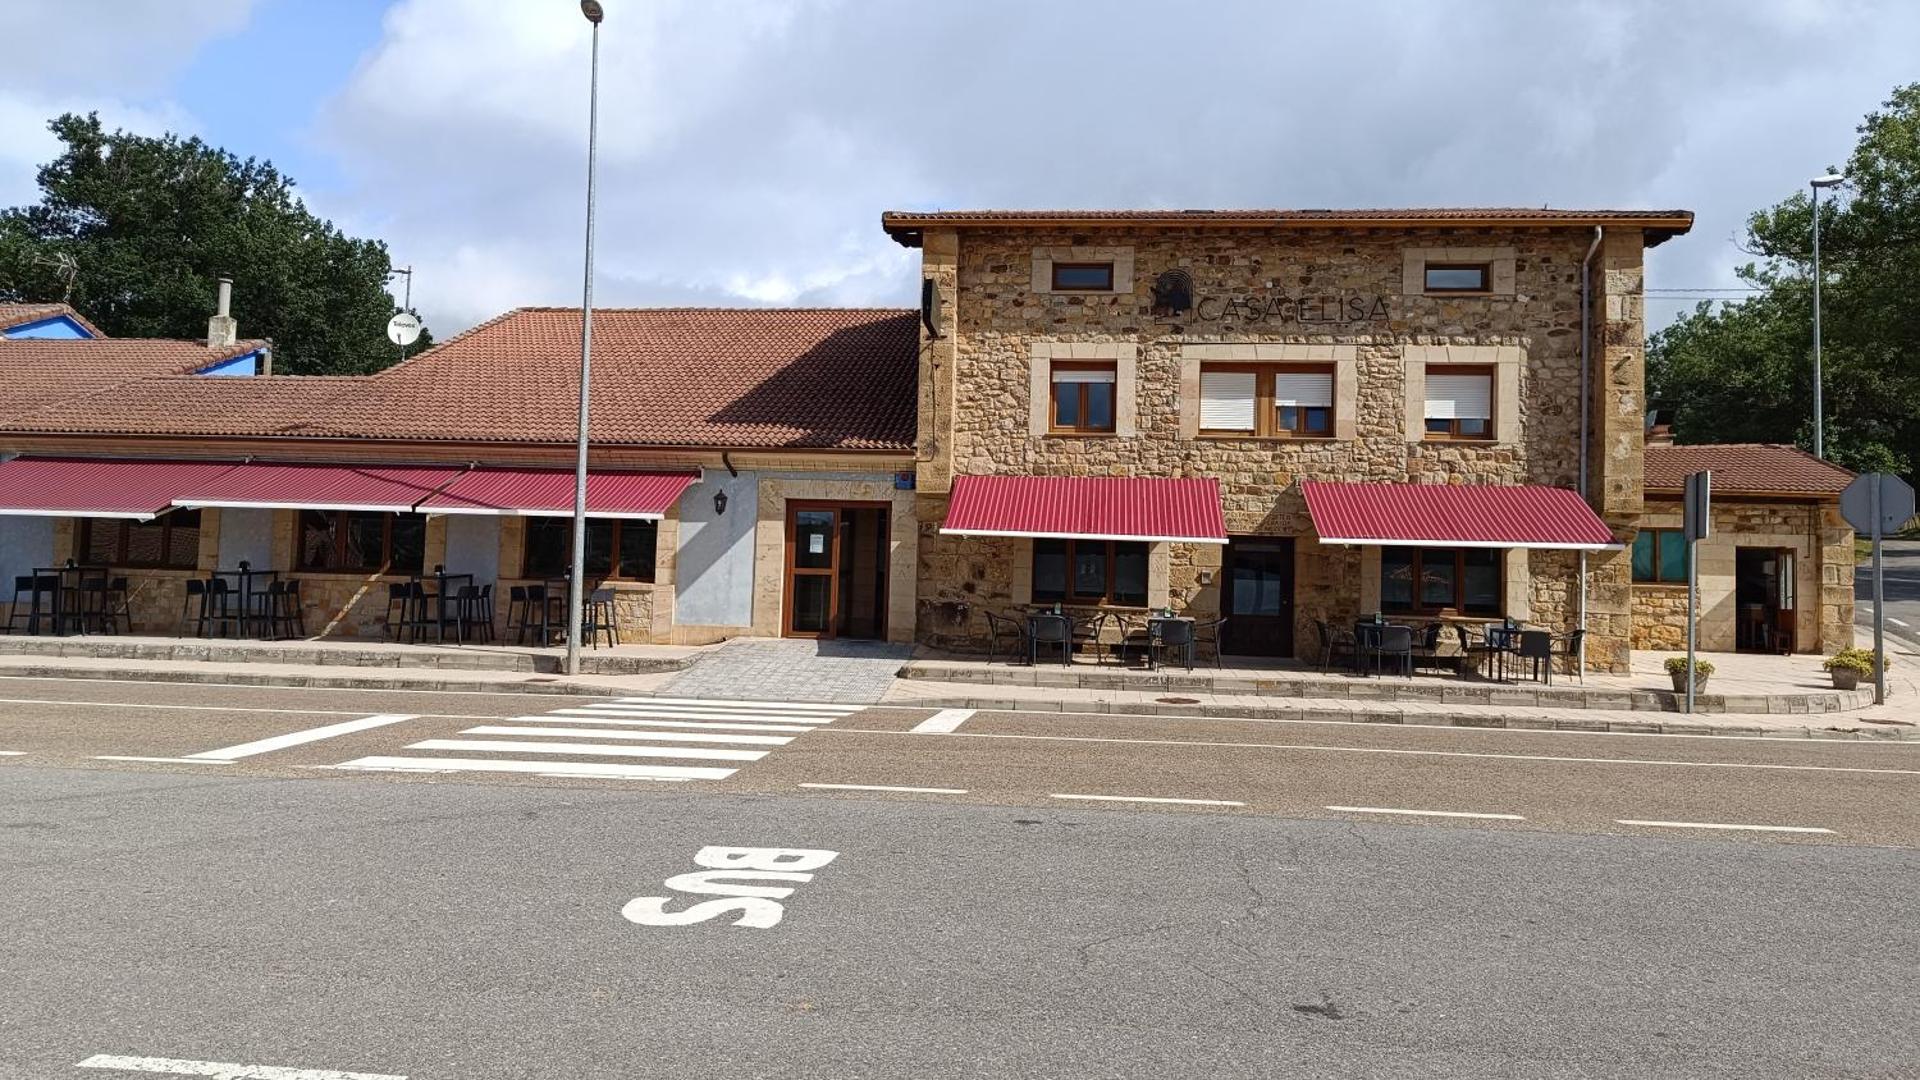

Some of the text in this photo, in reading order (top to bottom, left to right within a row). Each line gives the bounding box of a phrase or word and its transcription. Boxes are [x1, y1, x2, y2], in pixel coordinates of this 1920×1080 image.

[1197, 297, 1390, 322] CASA ELISA
[621, 846, 840, 929] BUS
